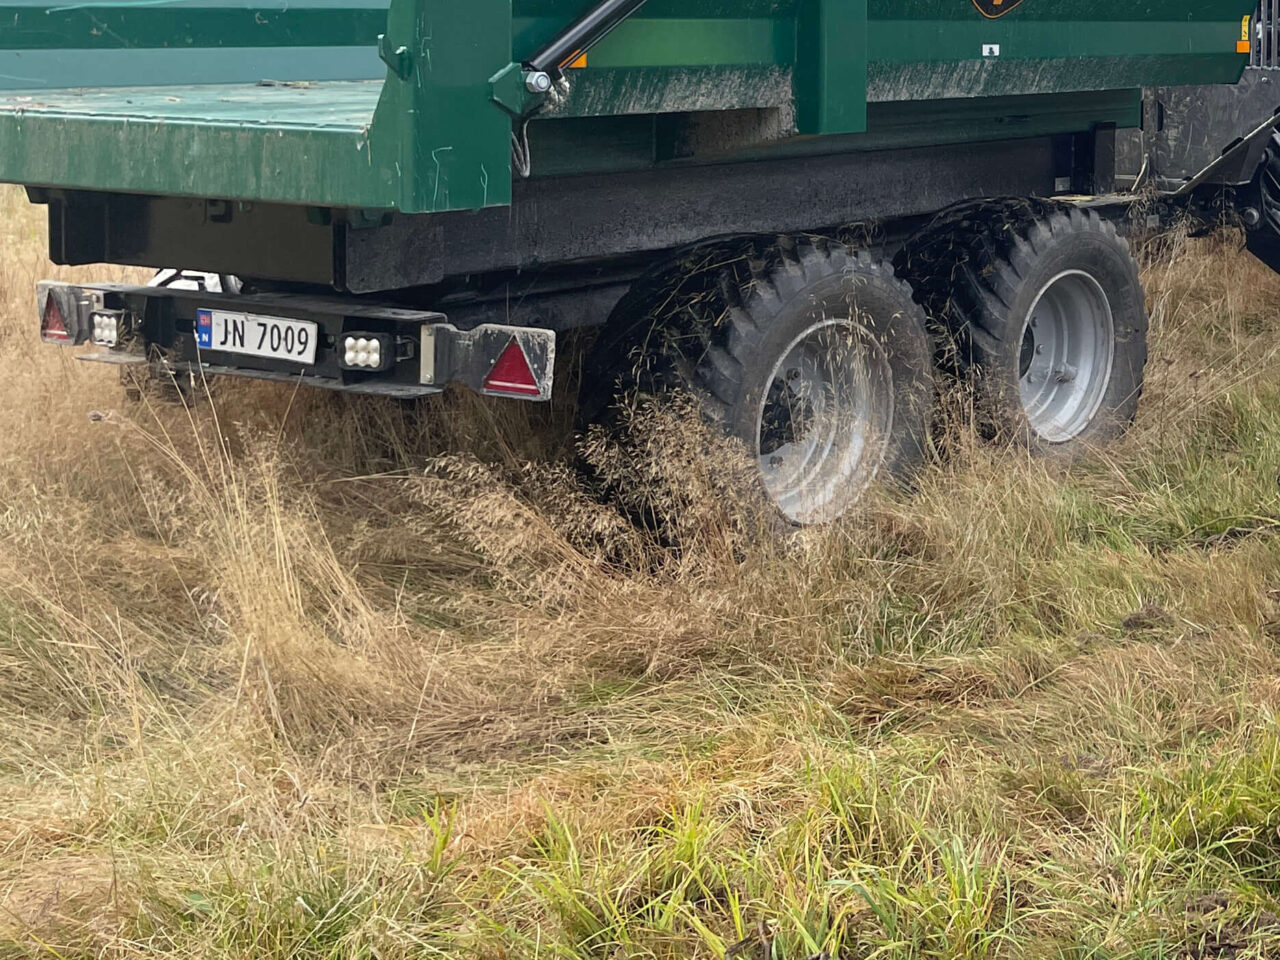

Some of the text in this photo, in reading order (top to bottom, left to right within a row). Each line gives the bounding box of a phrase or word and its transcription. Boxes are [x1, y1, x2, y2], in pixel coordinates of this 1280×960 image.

[201, 333, 209, 343] N
[220, 318, 309, 356] JN 7009
